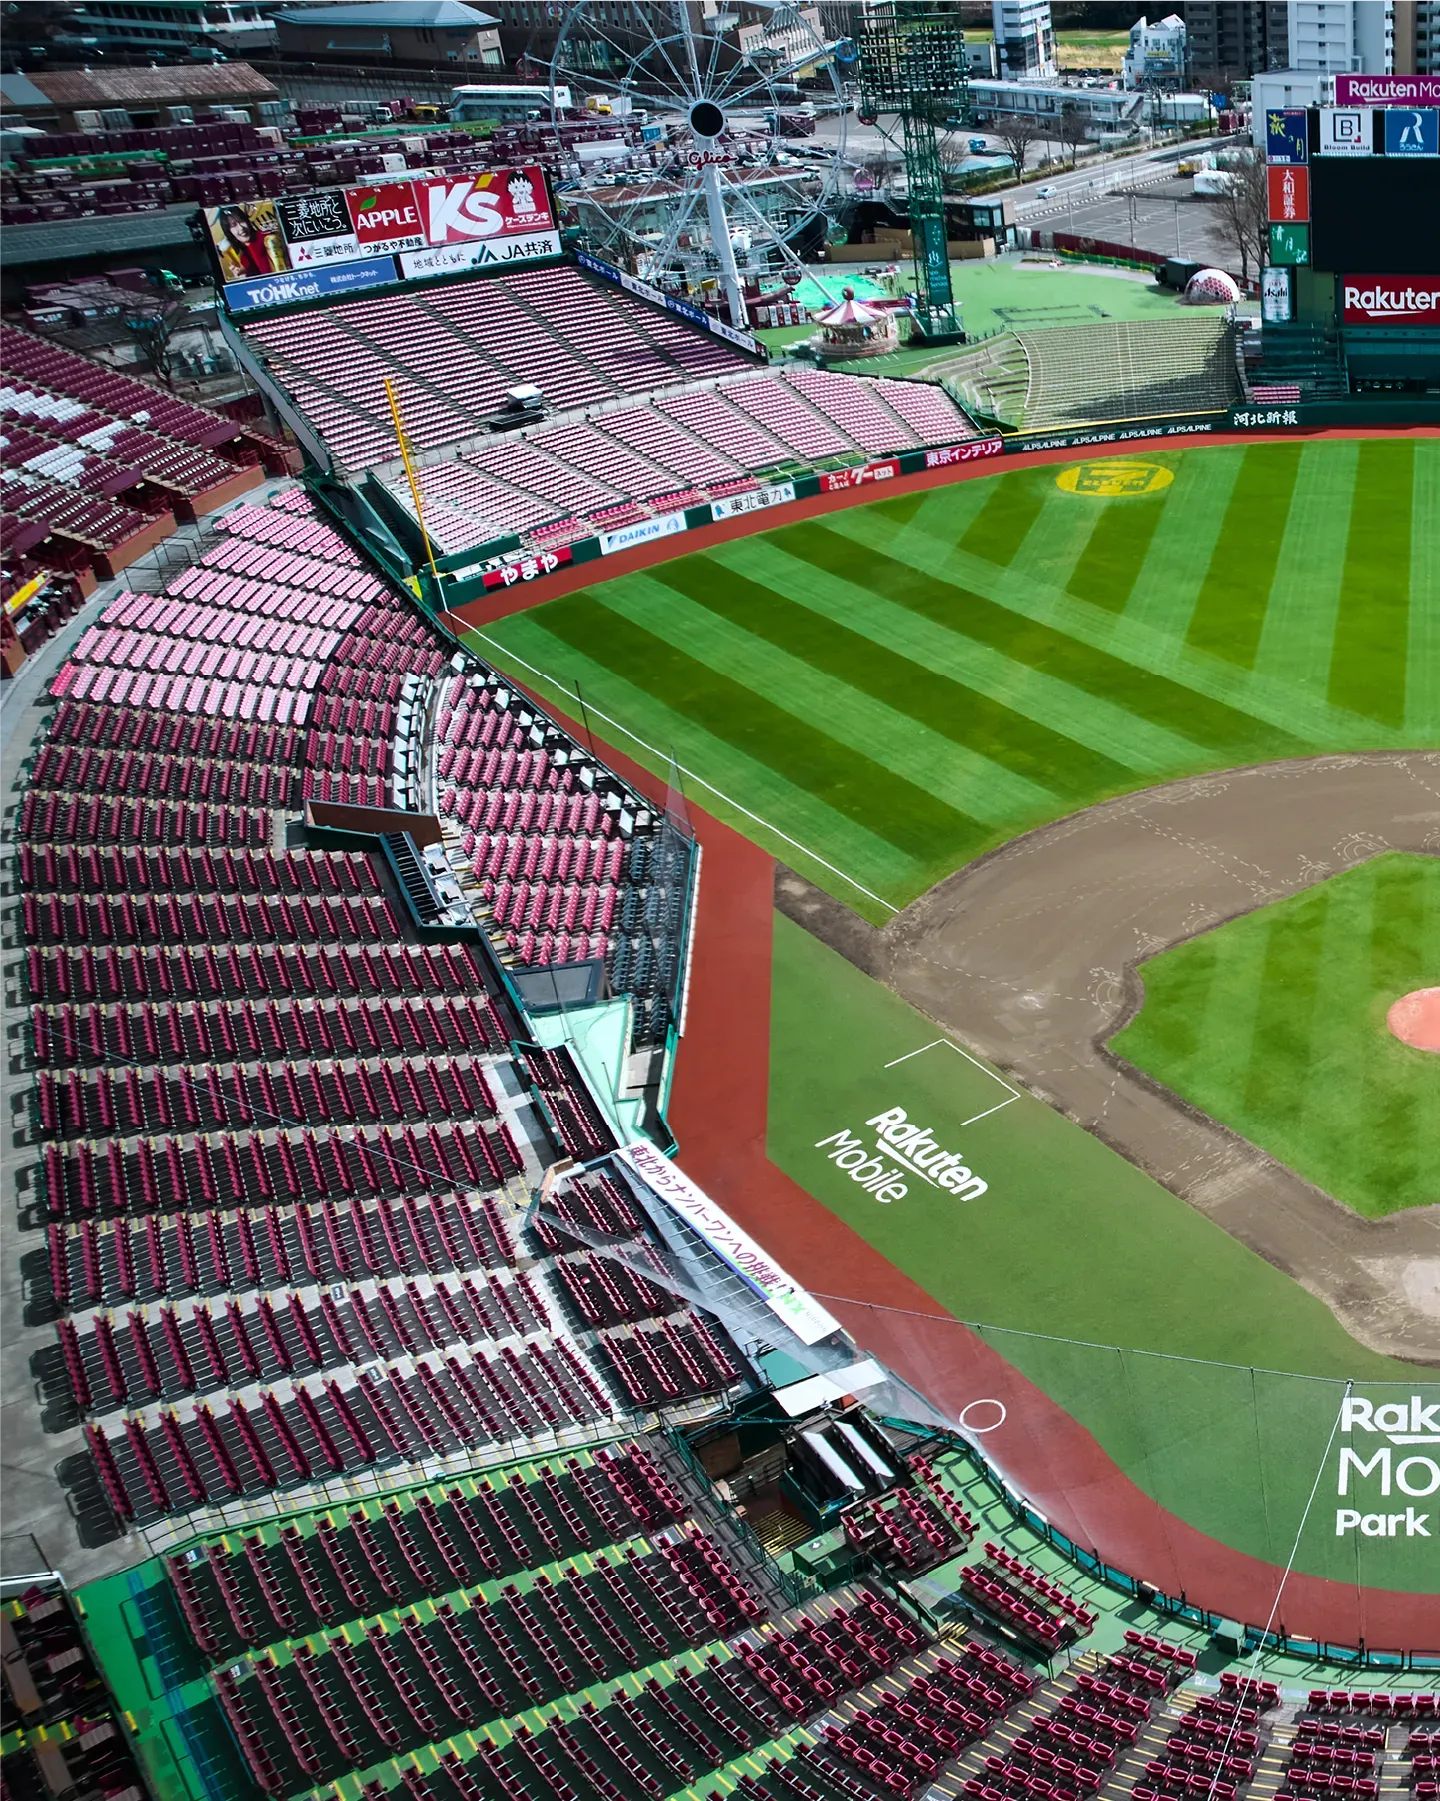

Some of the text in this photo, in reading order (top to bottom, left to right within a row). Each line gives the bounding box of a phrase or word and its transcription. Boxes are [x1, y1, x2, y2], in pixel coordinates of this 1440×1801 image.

[1349, 80, 1418, 101] Rakuten
[689, 151, 739, 170] Glico
[1282, 169, 1296, 219] 大和証券
[284, 196, 343, 221] 三菱地所と
[357, 206, 418, 230] APPLE
[505, 212, 549, 225] ケーズデンキ
[289, 218, 347, 237] 次にいこう。
[315, 243, 354, 259] 三菱地所
[363, 236, 424, 254] つがるや不動産
[501, 239, 553, 260] JA共済
[1272, 225, 1308, 264] 清月記
[413, 253, 466, 269] 地域とともに
[330, 270, 378, 283] 株式会社トークネット
[1264, 287, 1288, 298] Asahi
[1233, 410, 1299, 428] 河北新報
[926, 440, 1003, 467] 東京インテリア
[875, 468, 892, 478] ネット
[730, 488, 783, 514] 東北電力
[619, 524, 660, 544] DAIKIN
[500, 553, 559, 587] やまや
[865, 1106, 988, 1202] Rakuten
[814, 1128, 909, 1203] Mobile
[1336, 1507, 1431, 1536] Park
